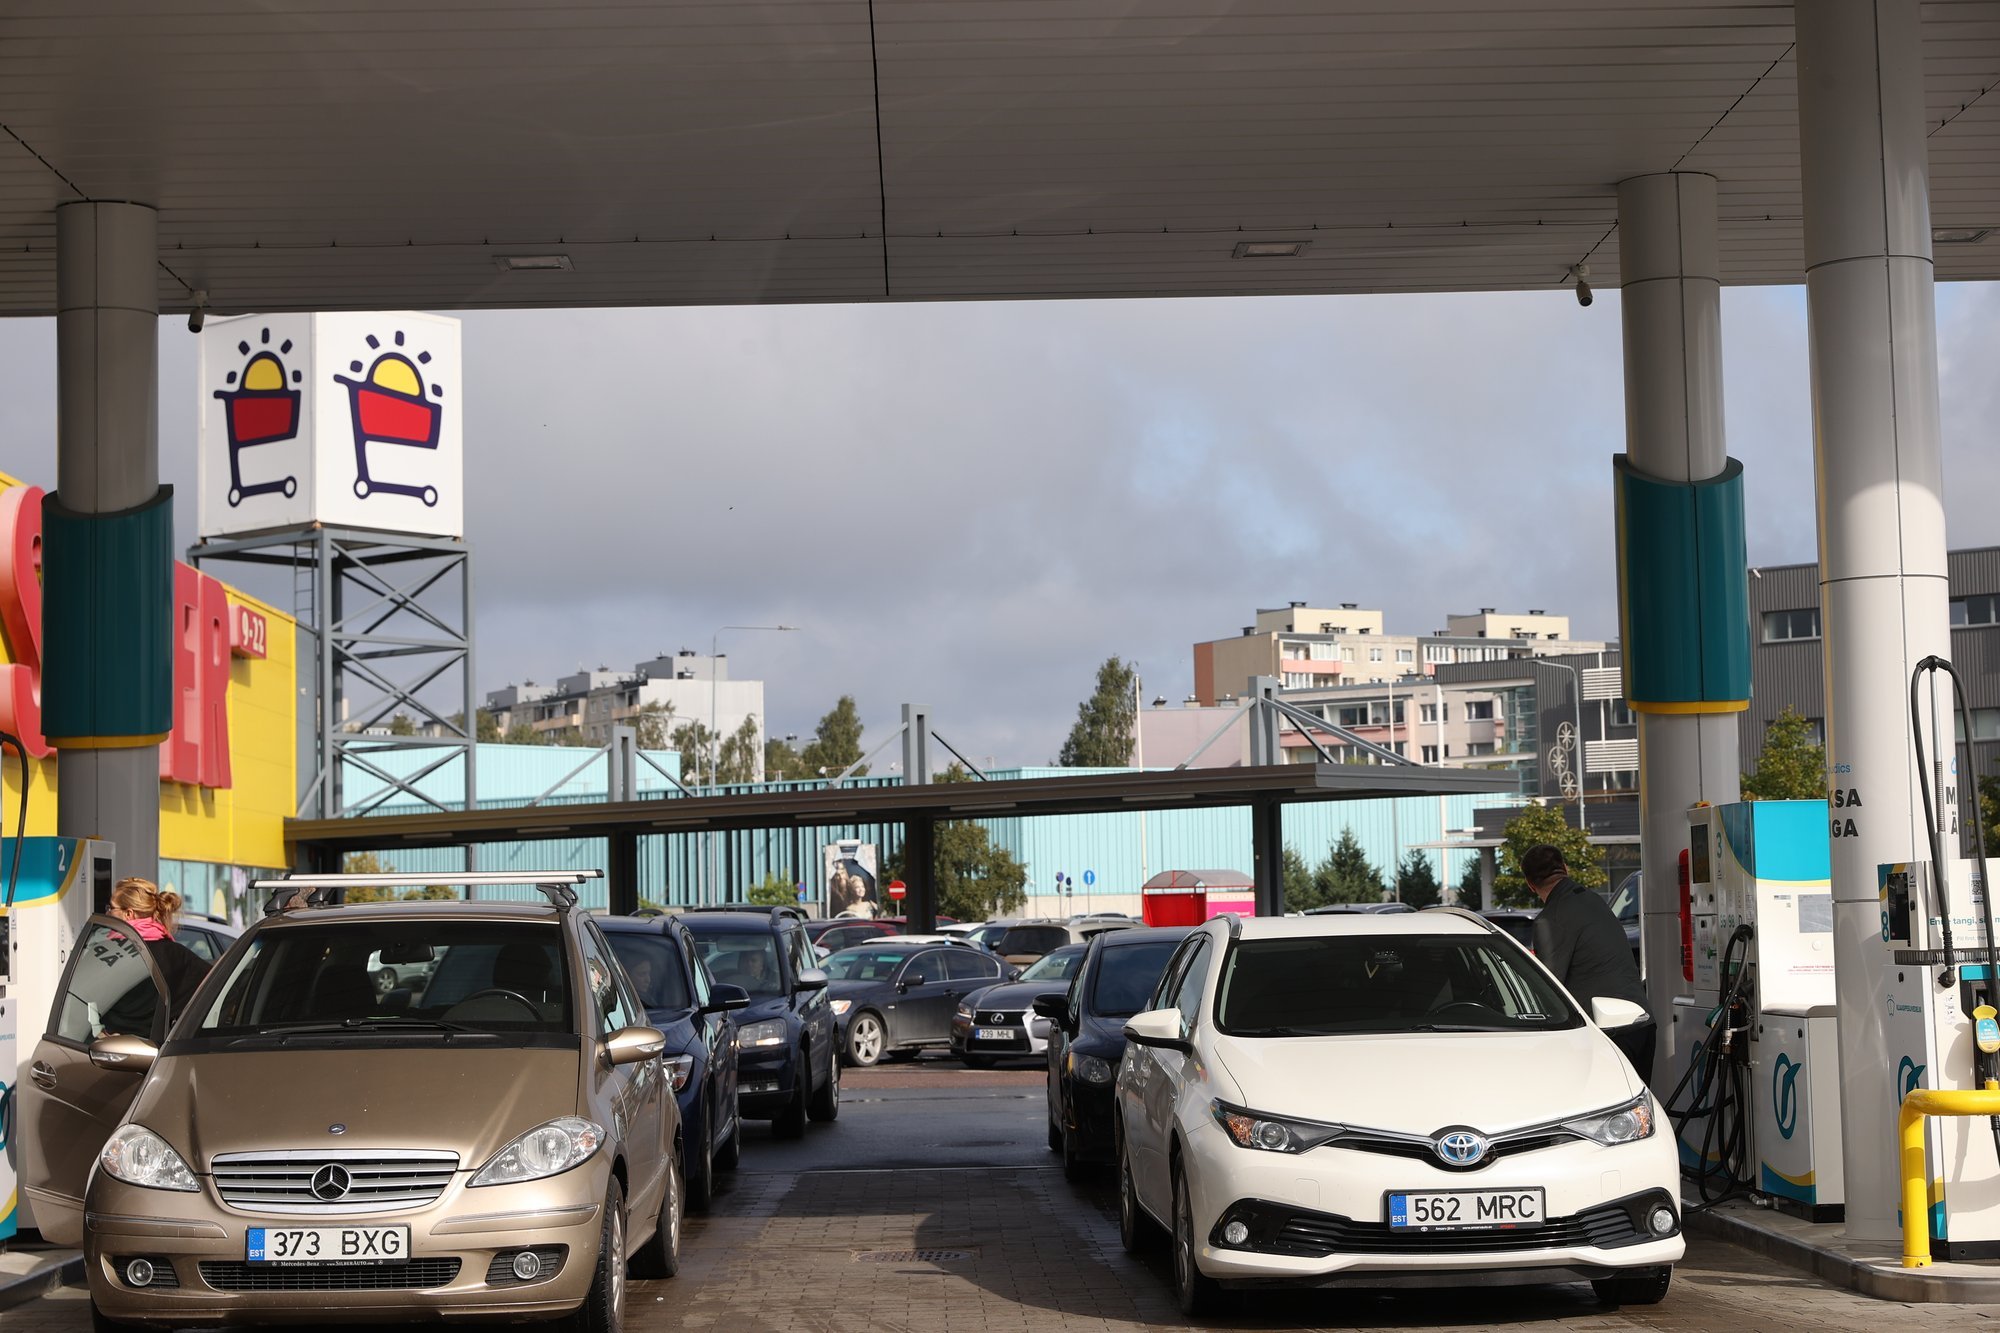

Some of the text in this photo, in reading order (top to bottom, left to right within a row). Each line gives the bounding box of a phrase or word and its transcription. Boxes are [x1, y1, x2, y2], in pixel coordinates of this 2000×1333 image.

[241, 610, 265, 654] 9-22
[58, 843, 66, 872] 2
[1716, 831, 1723, 859] 3
[1881, 910, 1890, 943] 8
[1392, 1215, 1406, 1223] EST
[1414, 1194, 1536, 1222] 562 MRC
[249, 1249, 264, 1257] EST
[273, 1229, 400, 1257] 373 BXG
